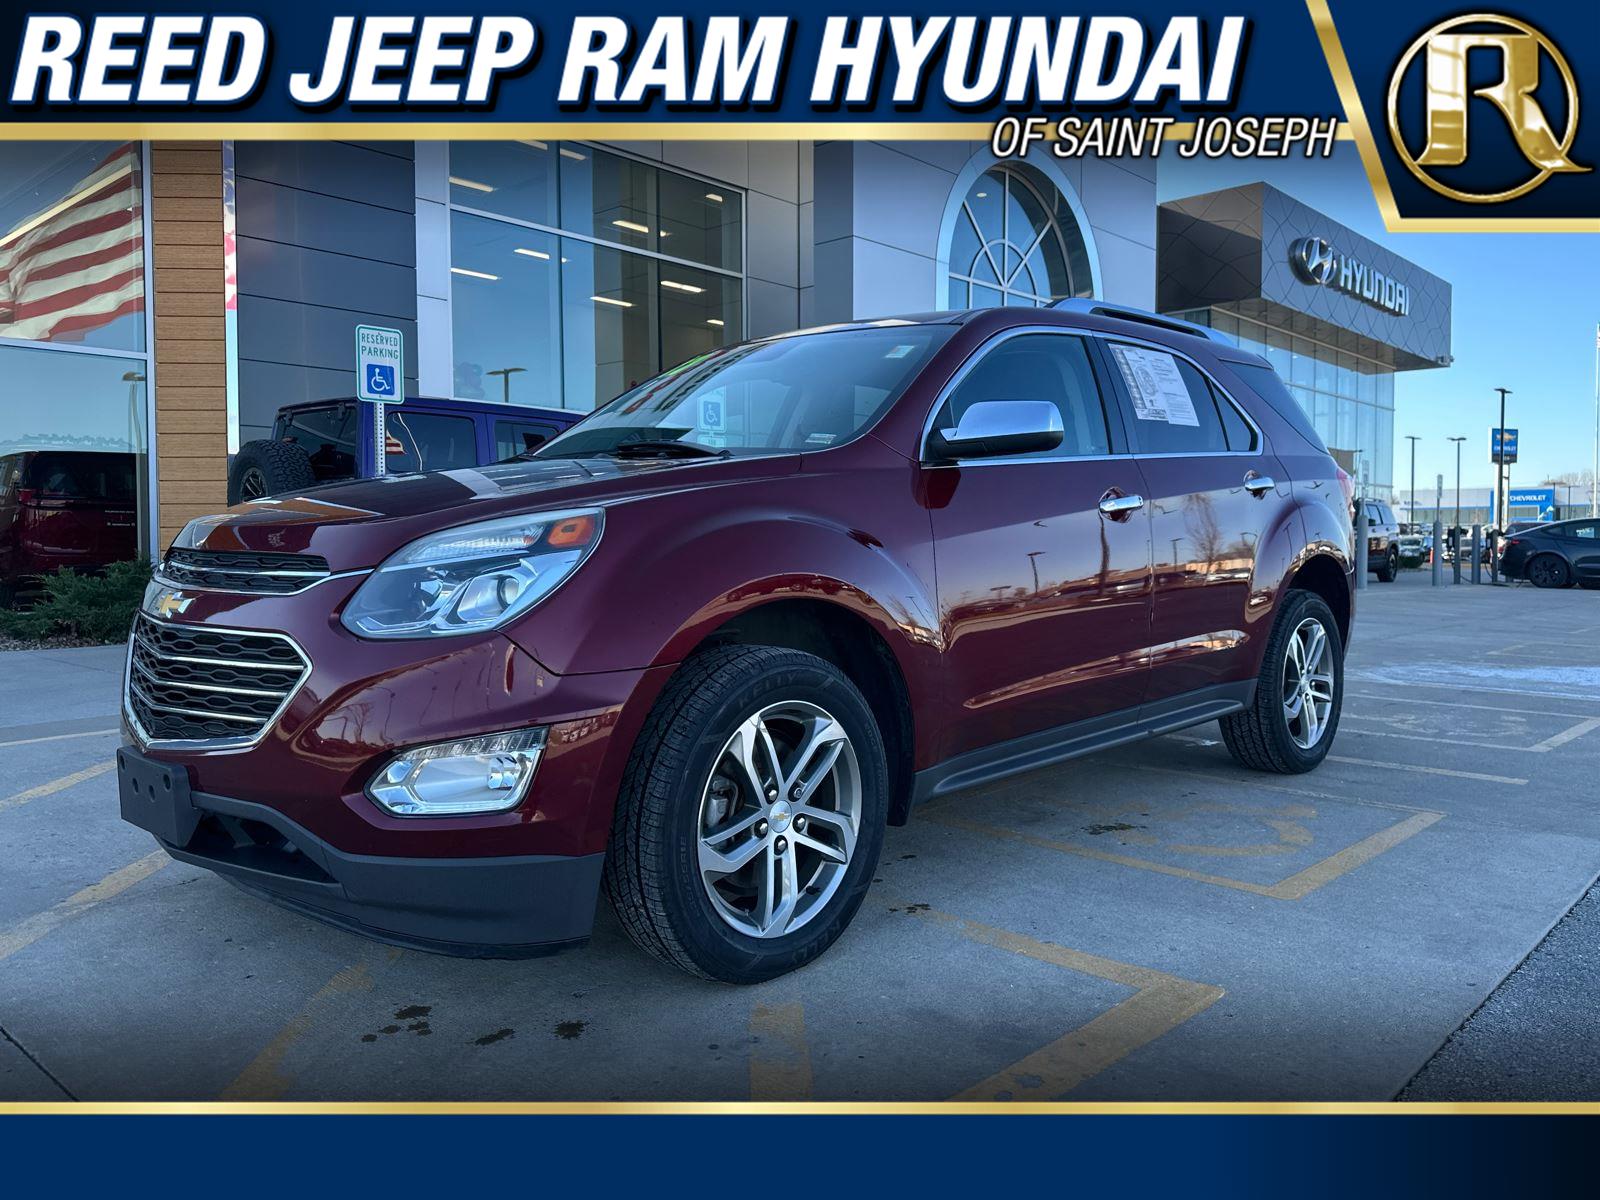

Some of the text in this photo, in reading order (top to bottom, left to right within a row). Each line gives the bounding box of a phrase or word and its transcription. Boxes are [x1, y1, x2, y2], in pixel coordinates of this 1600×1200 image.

[1339, 254, 1410, 316] HYUNDAI
[361, 332, 398, 347] RESERVED
[361, 345, 399, 360] PARKING
[1509, 494, 1547, 502] CHEVROLET
